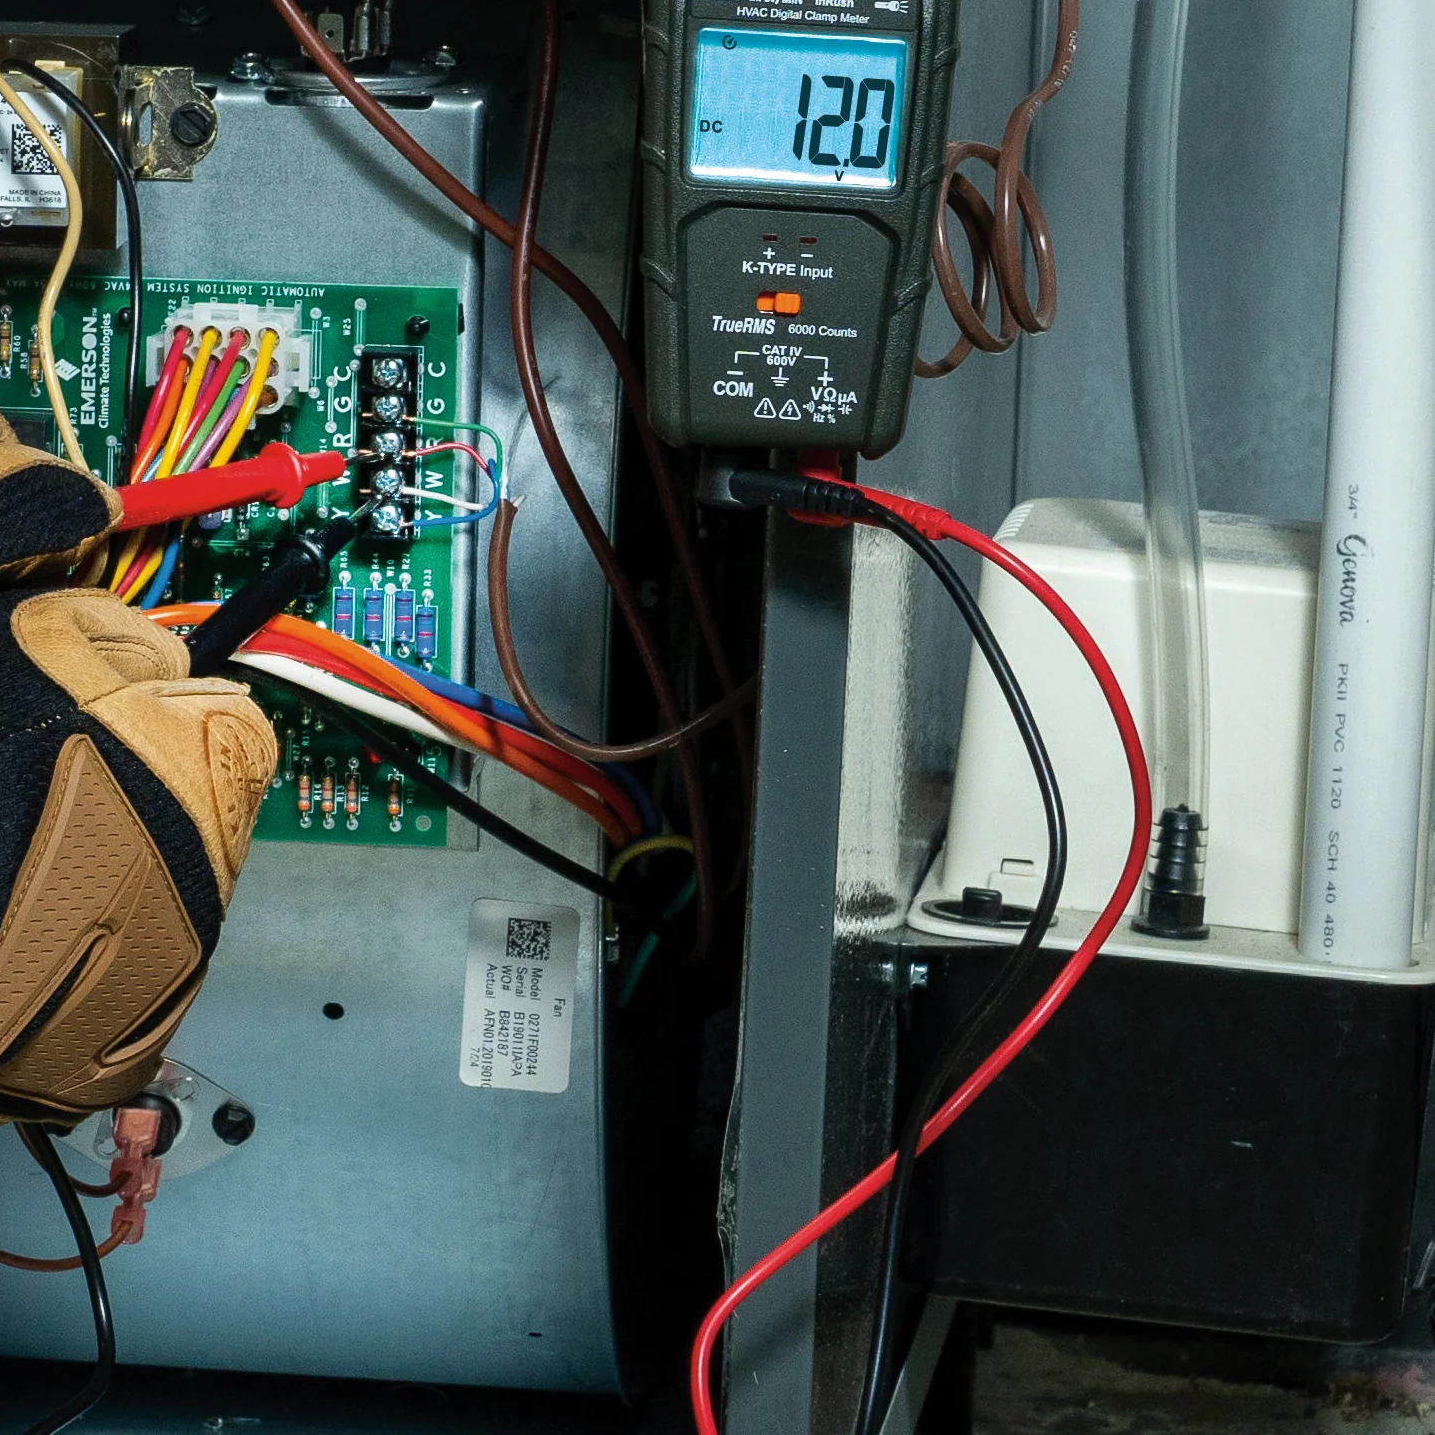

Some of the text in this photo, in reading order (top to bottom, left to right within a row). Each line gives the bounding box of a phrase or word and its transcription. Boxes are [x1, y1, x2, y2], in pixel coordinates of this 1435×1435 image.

[736, 6, 870, 24] HVAC Digital Clamp Meter
[699, 119, 723, 133] DC
[834, 170, 845, 182] V
[742, 261, 834, 280] K-TYPE Input
[147, 282, 190, 293] SYSTEM
[196, 284, 252, 295] IGNITION
[261, 285, 325, 297] AUTOMATIC
[322, 316, 331, 328] W3
[343, 318, 351, 336] W25
[712, 316, 858, 338] TrueRMS 6000 Counts
[13, 335, 21, 352] R60
[762, 344, 802, 357] CAT IV
[20, 352, 28, 369] R58
[427, 361, 446, 377] C
[766, 356, 796, 366] 600V
[80, 316, 98, 425] EMERSON
[98, 313, 113, 429] Climate Technologies
[333, 365, 352, 381] C
[713, 380, 754, 398] COM
[316, 400, 325, 412] W6
[334, 396, 352, 413] G
[427, 398, 445, 414] G
[813, 413, 825, 423] Hz
[333, 433, 352, 447] R
[425, 470, 444, 488] W
[423, 569, 432, 587] R33
[1334, 713, 1347, 753] PVC
[1330, 766, 1343, 810] 1120
[1327, 830, 1340, 872] SCH
[1325, 881, 1336, 904] 40
[485, 963, 498, 999] Actual
[516, 967, 528, 998] Serial
[530, 967, 543, 1001] Model
[498, 965, 513, 1057] WO# B842187
[553, 998, 566, 1017] Fan
